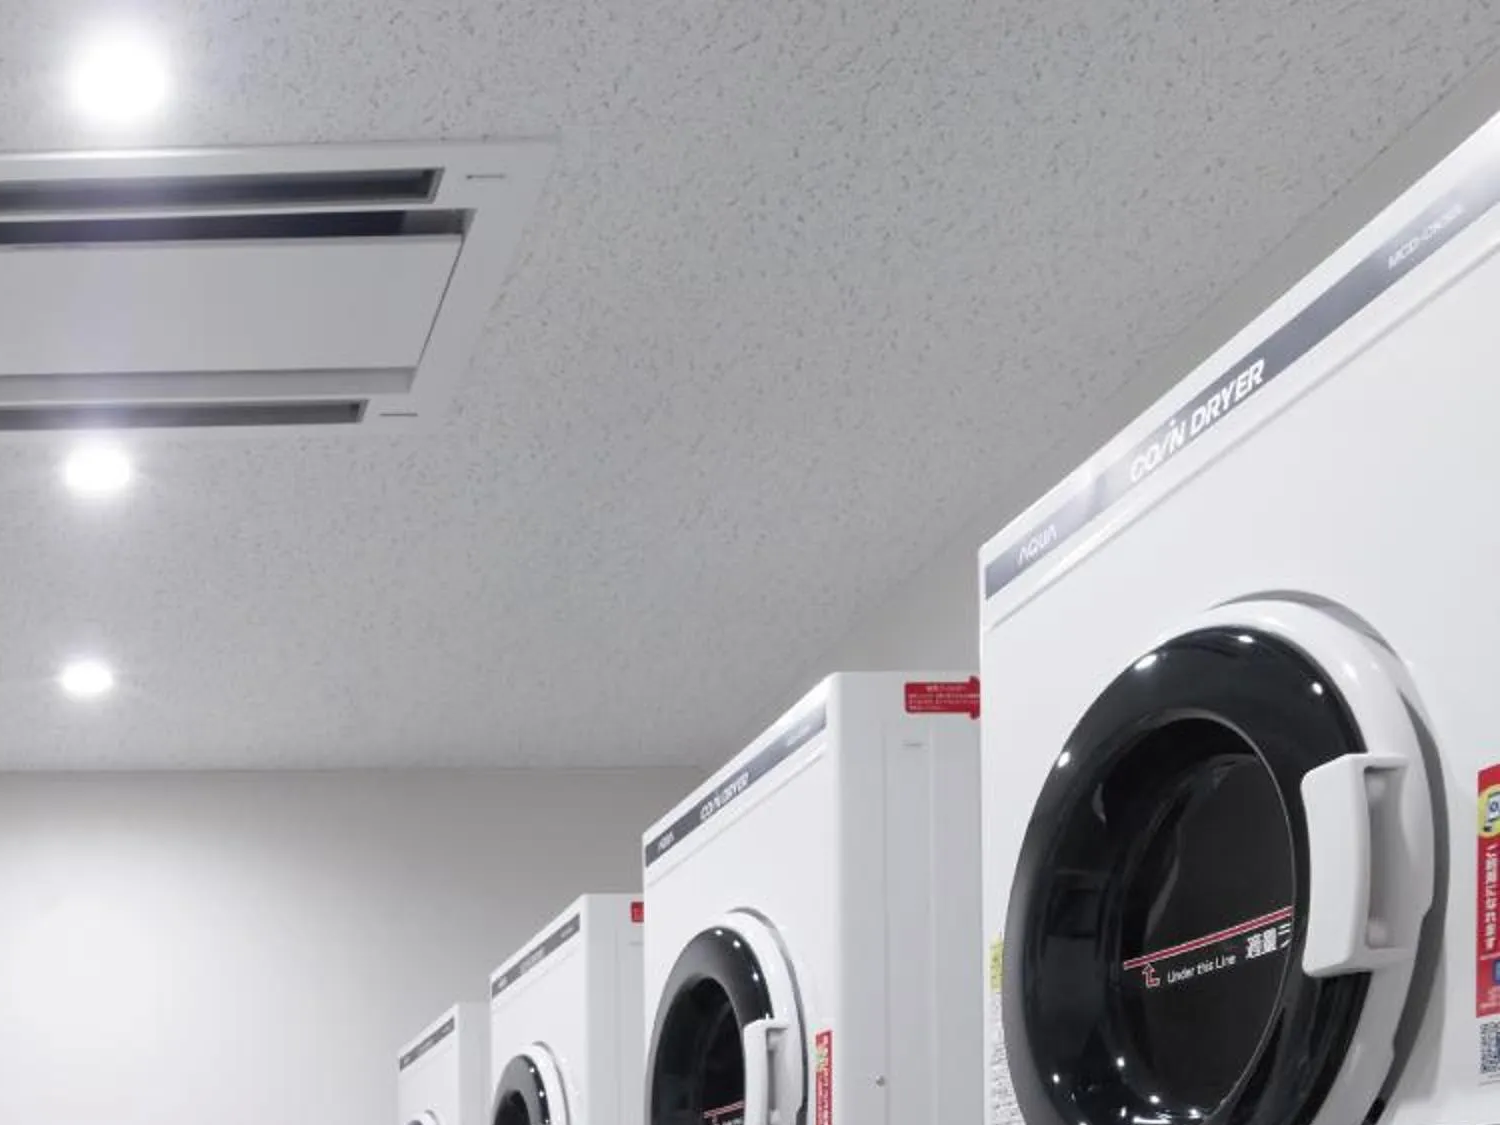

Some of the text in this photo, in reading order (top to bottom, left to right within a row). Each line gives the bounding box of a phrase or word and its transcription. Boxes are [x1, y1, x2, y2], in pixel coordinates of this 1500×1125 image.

[1190, 360, 1265, 437] DRYER
[1016, 524, 1057, 567] AQUA
[1215, 953, 1237, 969] Line
